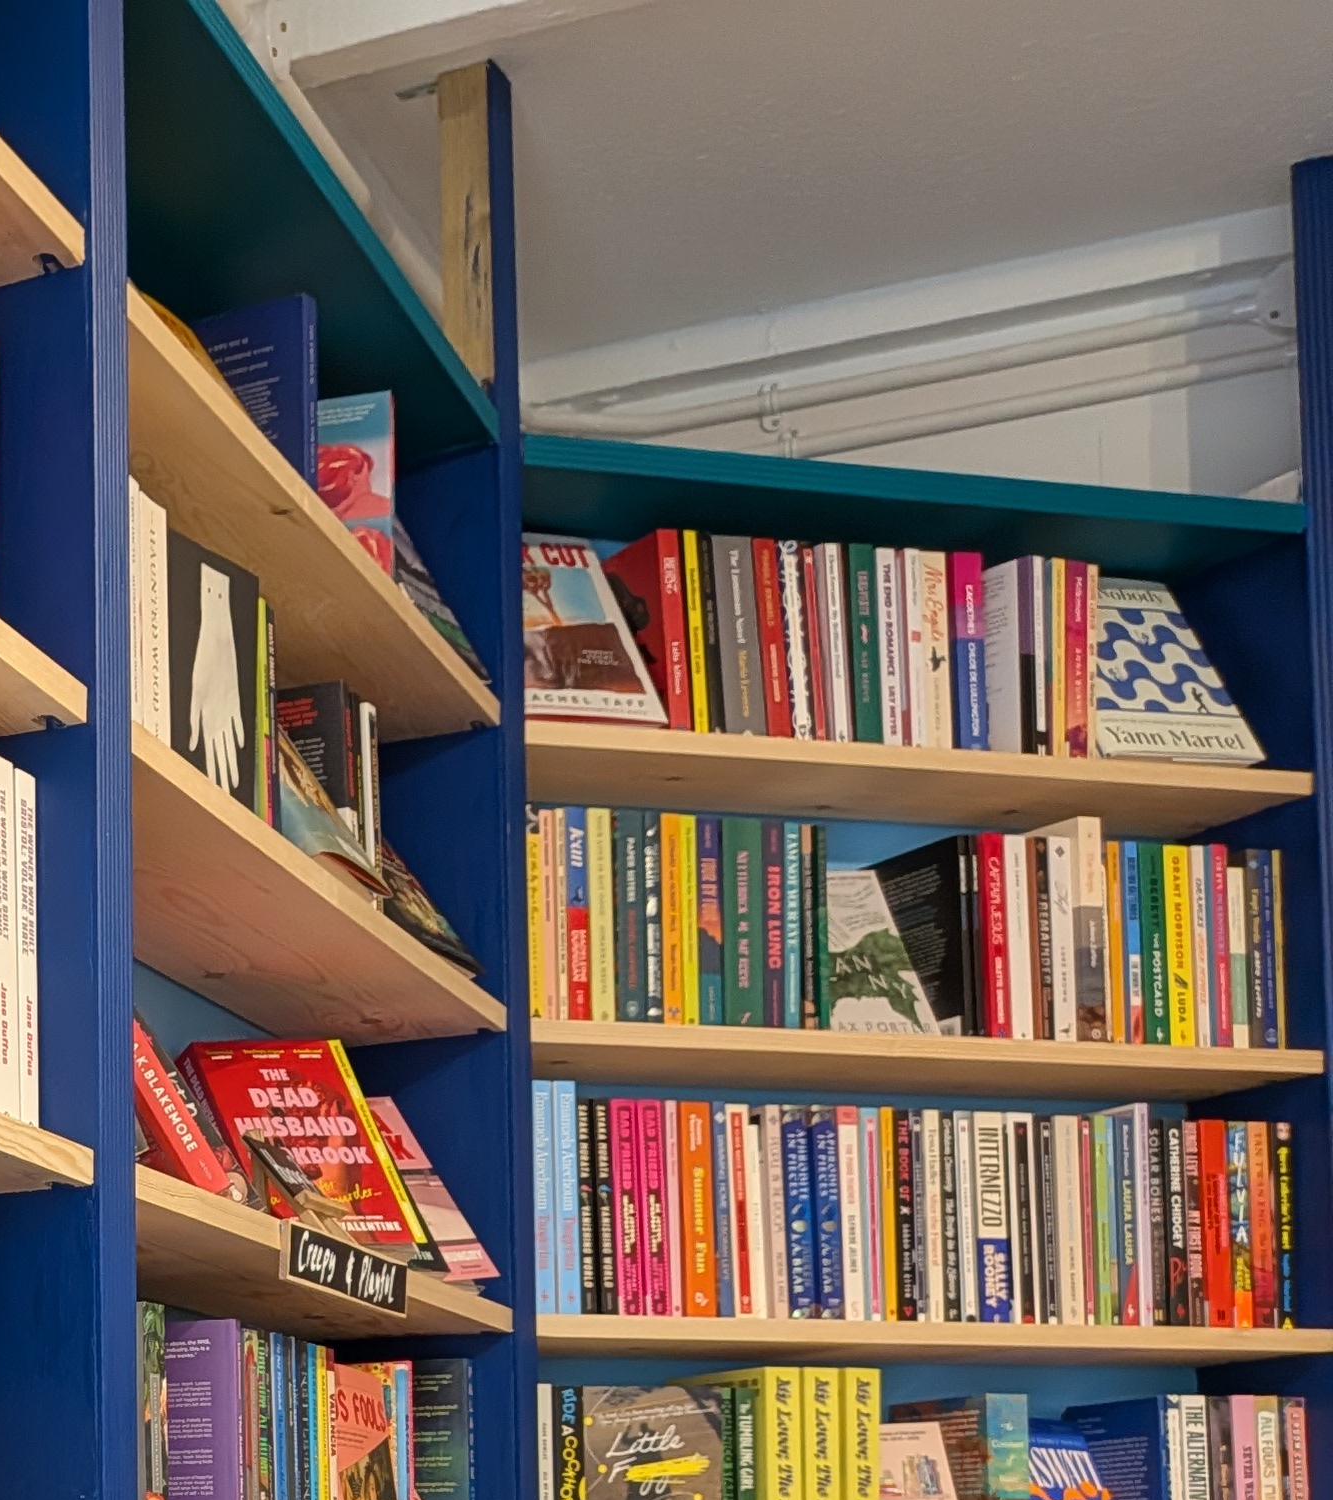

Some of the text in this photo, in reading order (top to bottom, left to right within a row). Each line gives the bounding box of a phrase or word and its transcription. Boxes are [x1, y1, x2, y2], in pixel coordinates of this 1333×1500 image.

[1106, 724, 1247, 751] Yann Martel
[766, 864, 784, 971] IRON LUNG
[1173, 901, 1186, 972] MORRISON
[1178, 990, 1188, 1024] LUDA
[247, 1086, 320, 1109] DEAD
[258, 1067, 291, 1083] THE
[233, 1116, 358, 1138] HUSBAND
[978, 1126, 1005, 1228] INTERMEZZO
[1167, 1127, 1185, 1250] CATHERINE CHIDGEY
[296, 1229, 337, 1286] Creepy
[983, 1243, 998, 1308] ROONEY
[993, 1251, 1009, 1303] SALLY
[1184, 1404, 1204, 1433] THE
